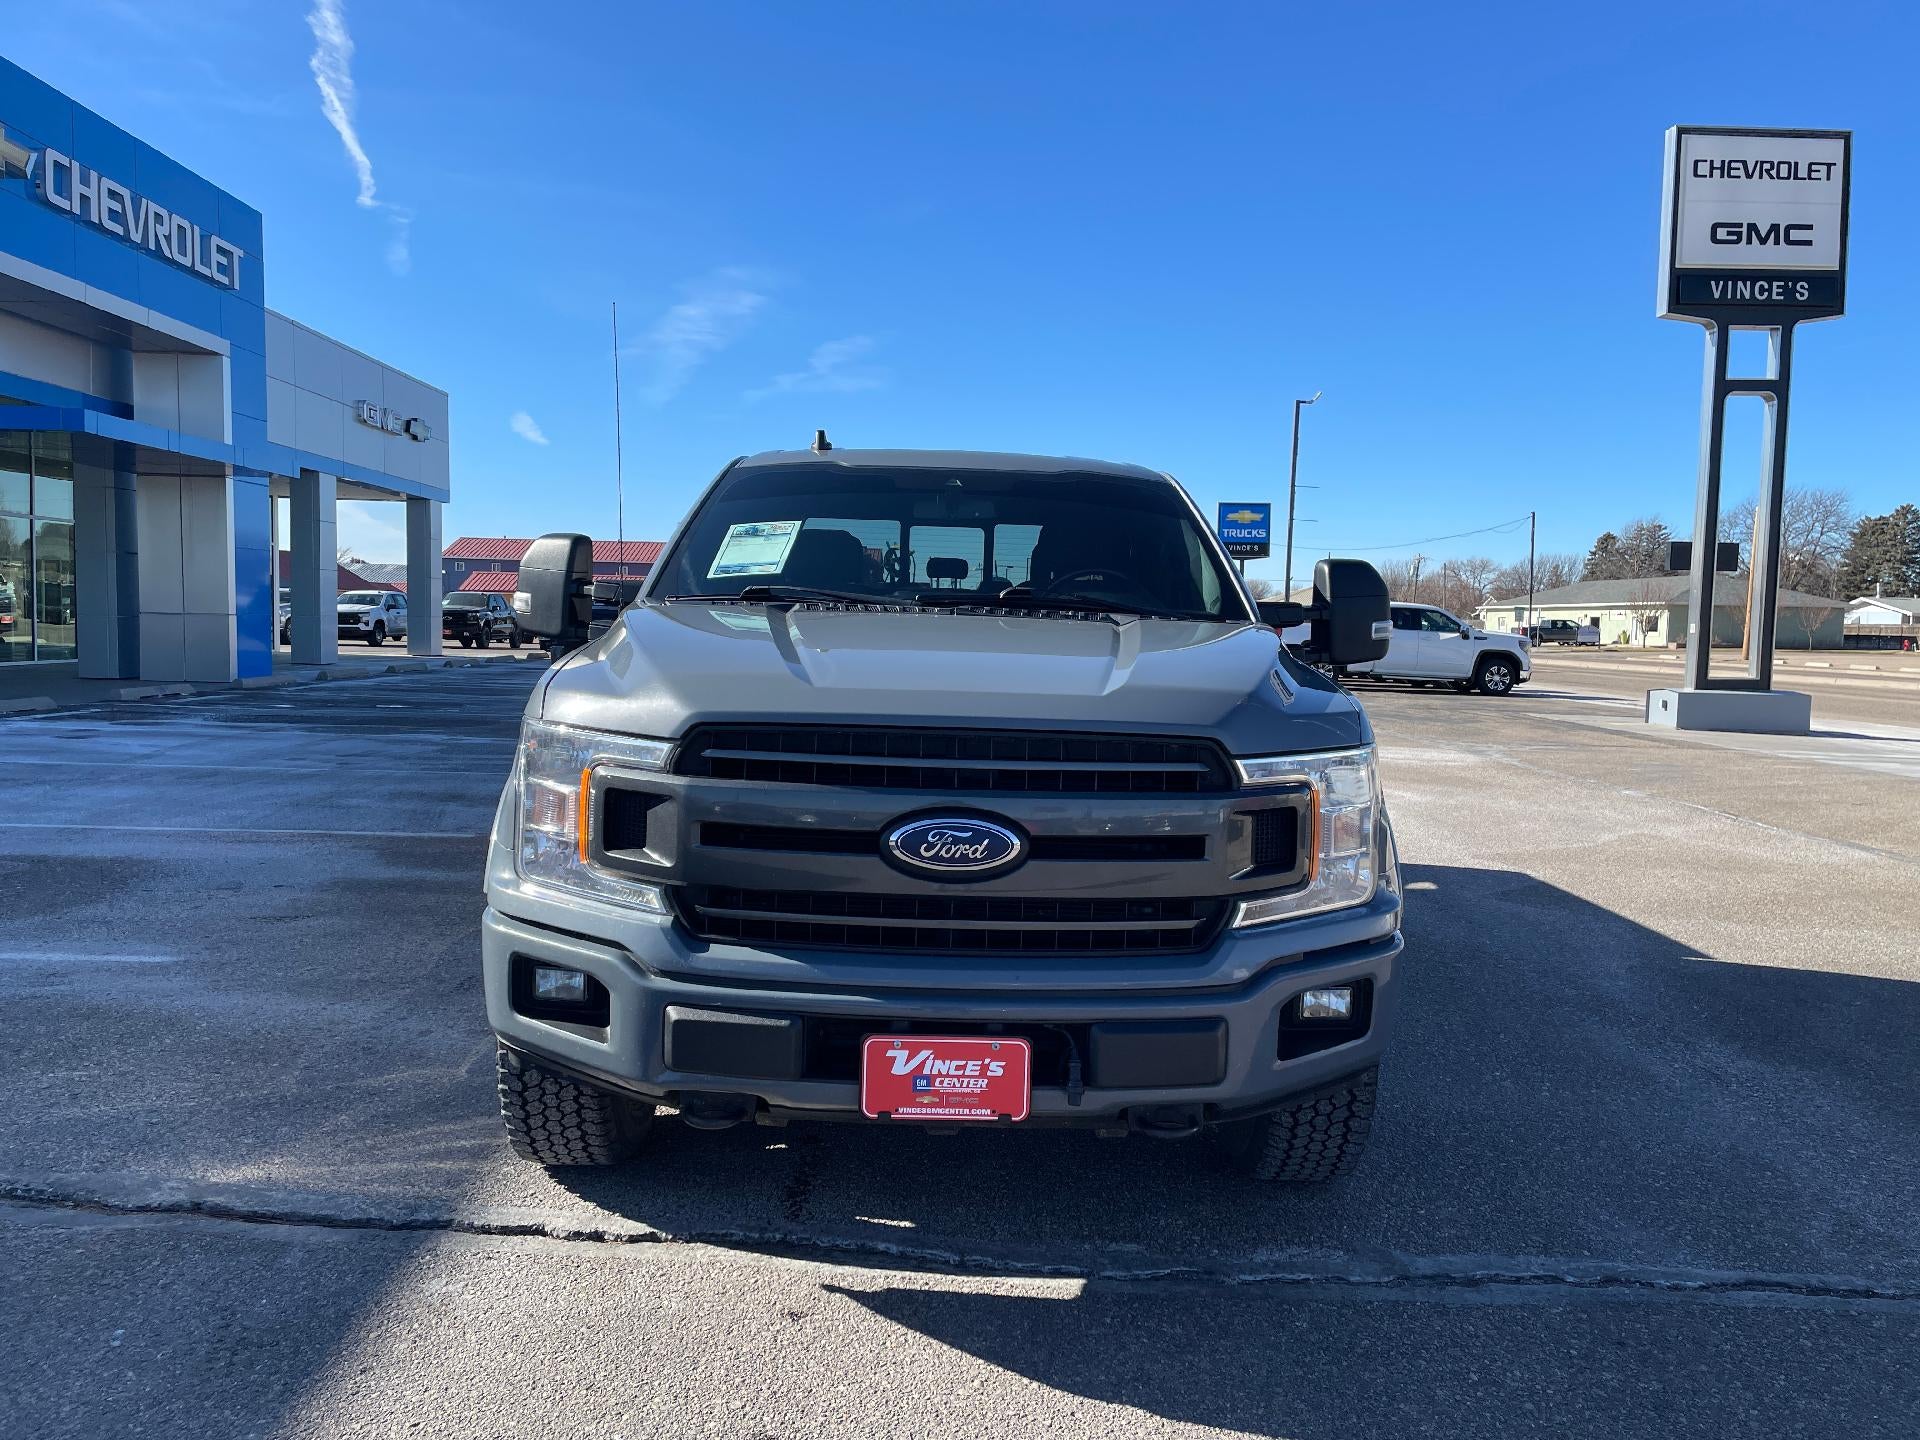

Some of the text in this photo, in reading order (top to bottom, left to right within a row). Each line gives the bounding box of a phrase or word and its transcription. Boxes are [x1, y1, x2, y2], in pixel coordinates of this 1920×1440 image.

[1692, 159, 1837, 182] CHEVROLET
[44, 147, 244, 291] CHEVROLET
[1710, 221, 1814, 246] GMC
[1710, 280, 1809, 300] VINCE'S
[1222, 528, 1267, 538] TRUCKS
[1228, 544, 1259, 552] VINCE'S
[920, 829, 990, 859] Ford
[916, 1077, 989, 1088] GM CENTER
